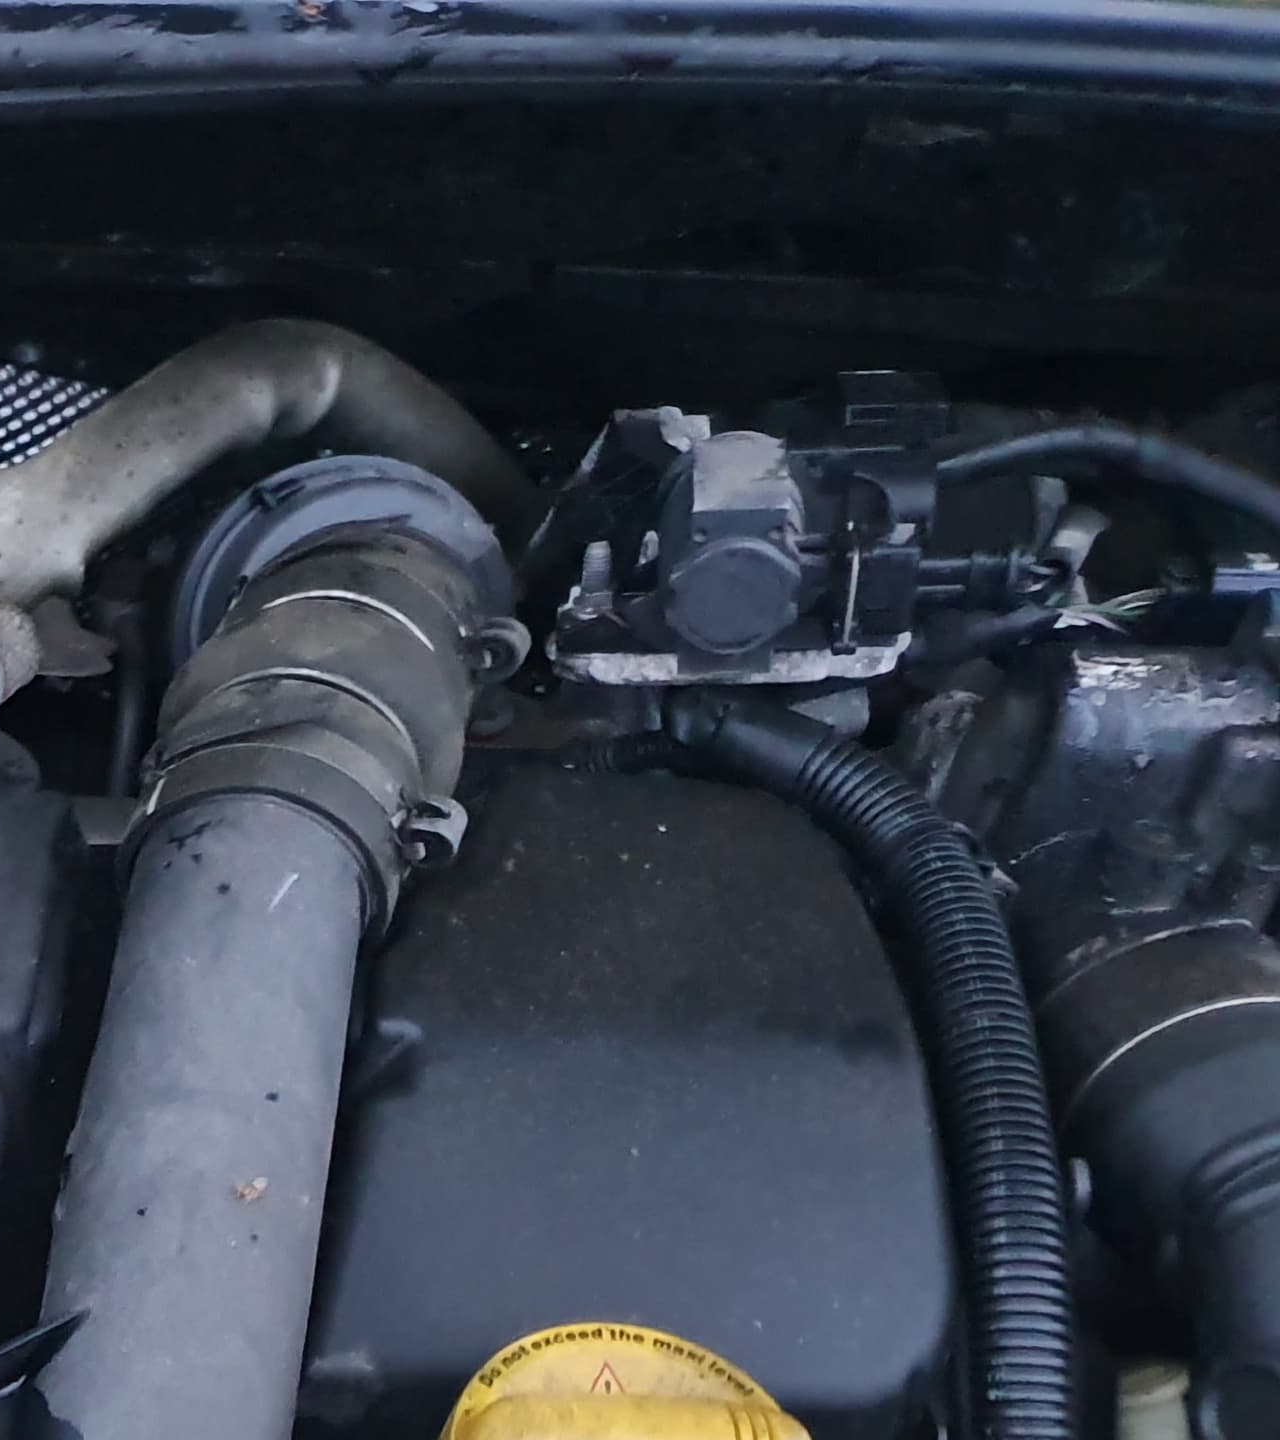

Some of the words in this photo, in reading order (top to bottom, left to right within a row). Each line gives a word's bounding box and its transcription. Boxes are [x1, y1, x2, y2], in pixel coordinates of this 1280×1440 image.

[478, 1366, 501, 1388] Do
[501, 1344, 531, 1370] not
[531, 1327, 603, 1351] exceed
[608, 1326, 645, 1344] the
[652, 1337, 707, 1365] maxi
[708, 1360, 755, 1397] level
